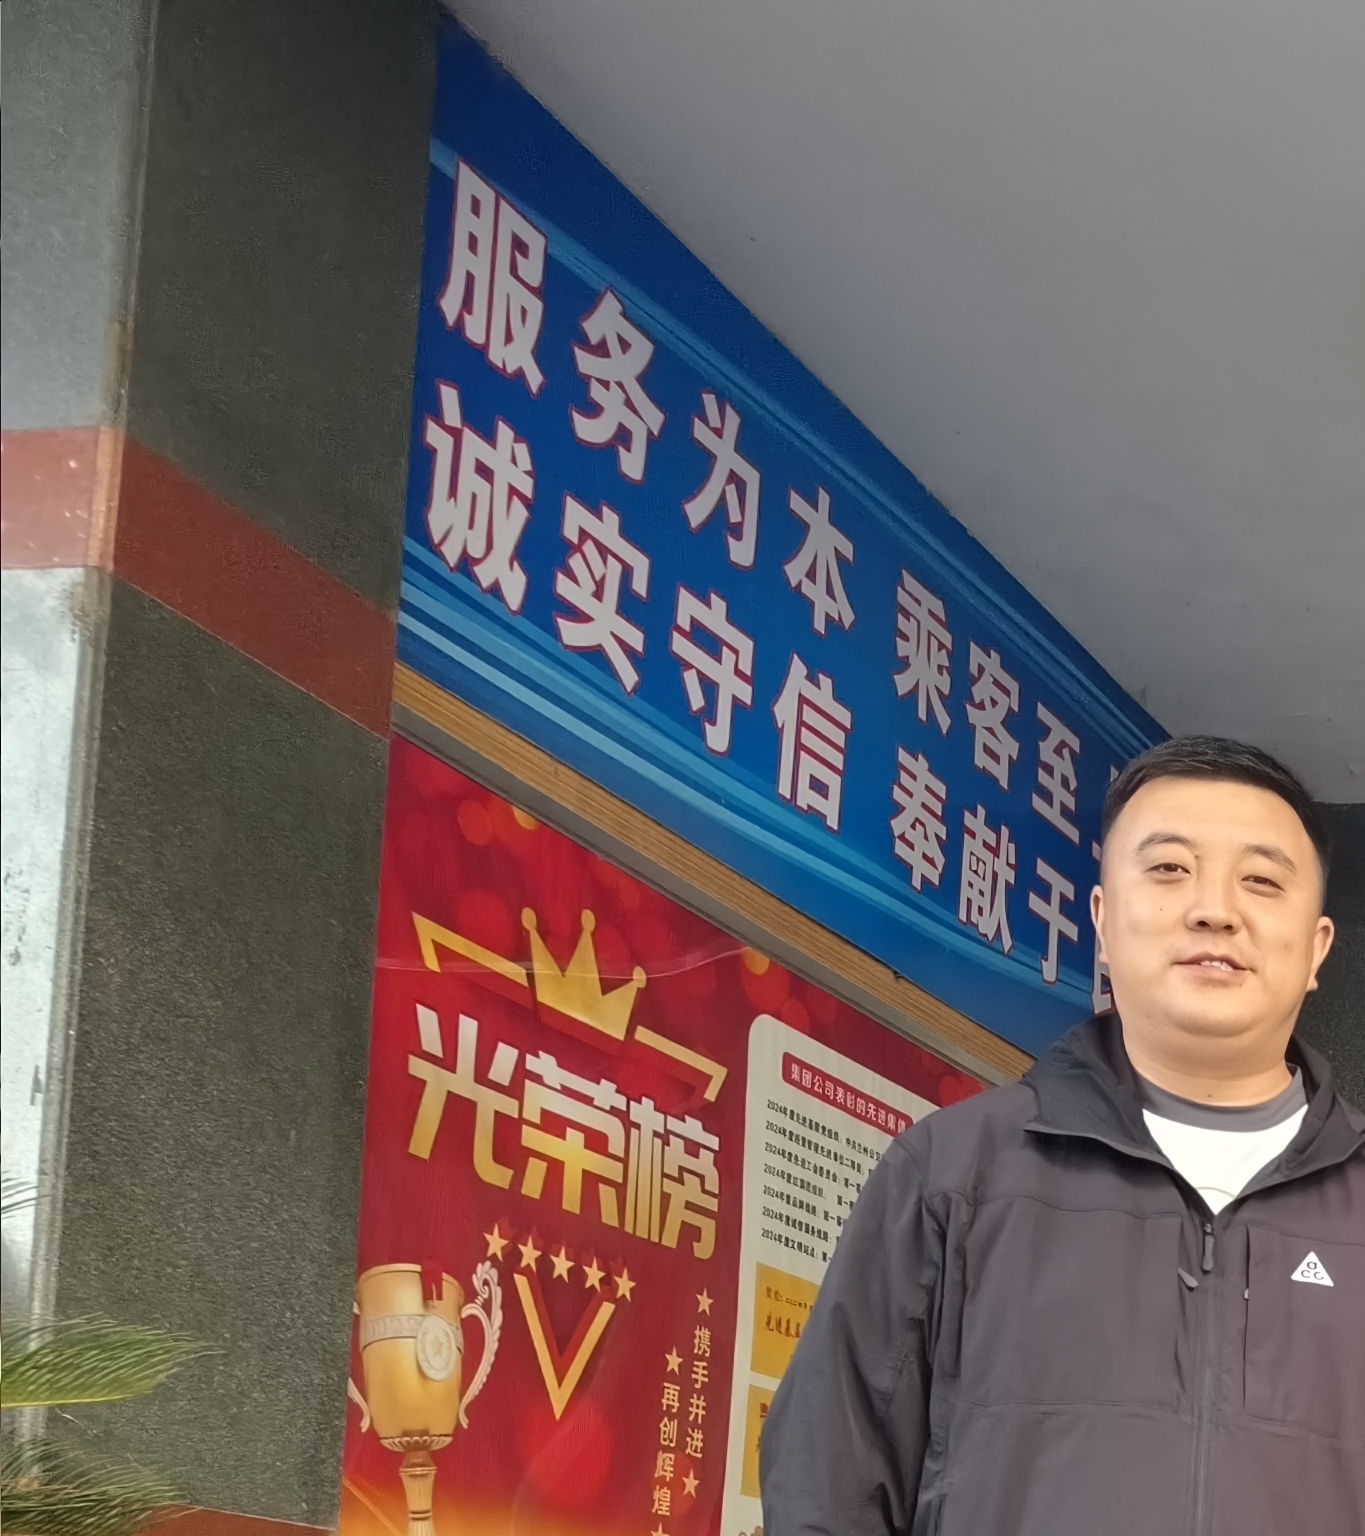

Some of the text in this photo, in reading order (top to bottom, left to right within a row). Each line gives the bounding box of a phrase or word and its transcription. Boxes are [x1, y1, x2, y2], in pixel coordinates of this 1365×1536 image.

[438, 157, 1118, 862] 服务为本 乘客至
[423, 383, 1115, 1014] 诚实守信 奉献于
[407, 1003, 723, 1261] 光荣榜
[652, 1383, 680, 1517] 再创辉煌
[686, 1326, 711, 1459] 携手并进
